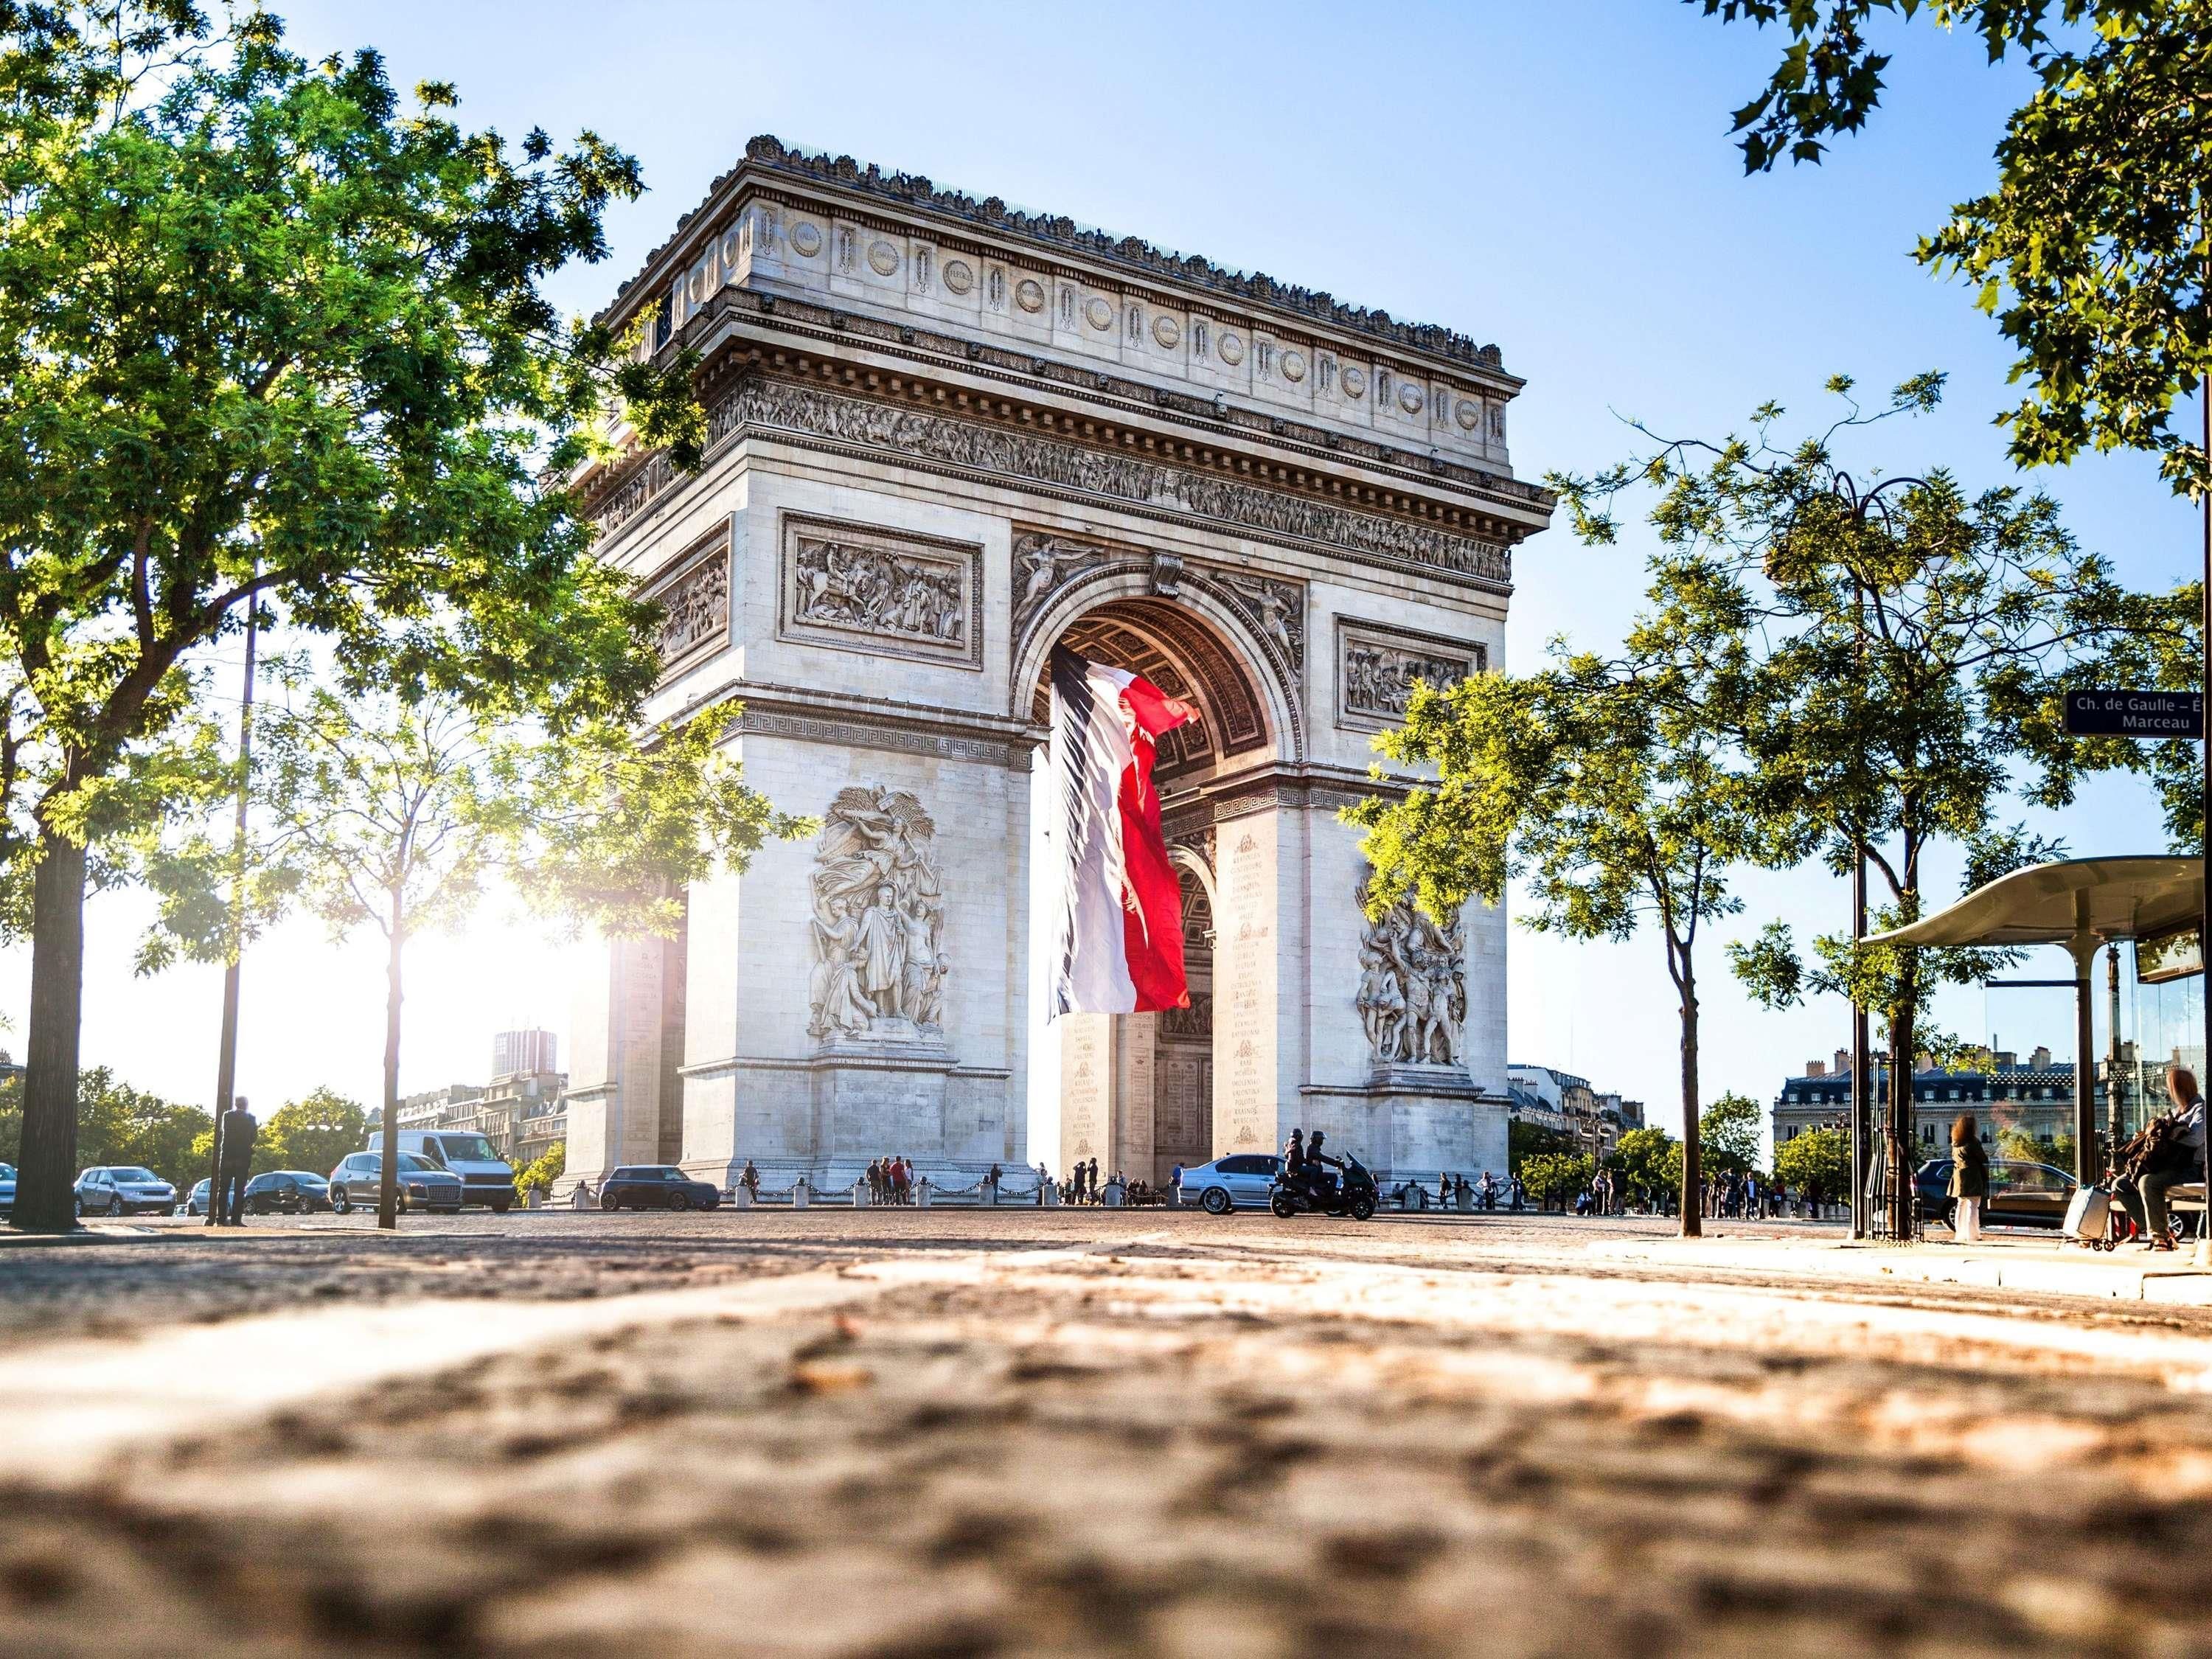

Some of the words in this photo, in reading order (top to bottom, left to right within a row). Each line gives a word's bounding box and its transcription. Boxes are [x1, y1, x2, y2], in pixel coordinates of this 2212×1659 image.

[2076, 697, 2100, 710] Ch.
[2105, 698, 2123, 710] de
[2128, 698, 2175, 712] Gaulle
[2192, 697, 2204, 712] É
[2123, 715, 2190, 728] Marceau
